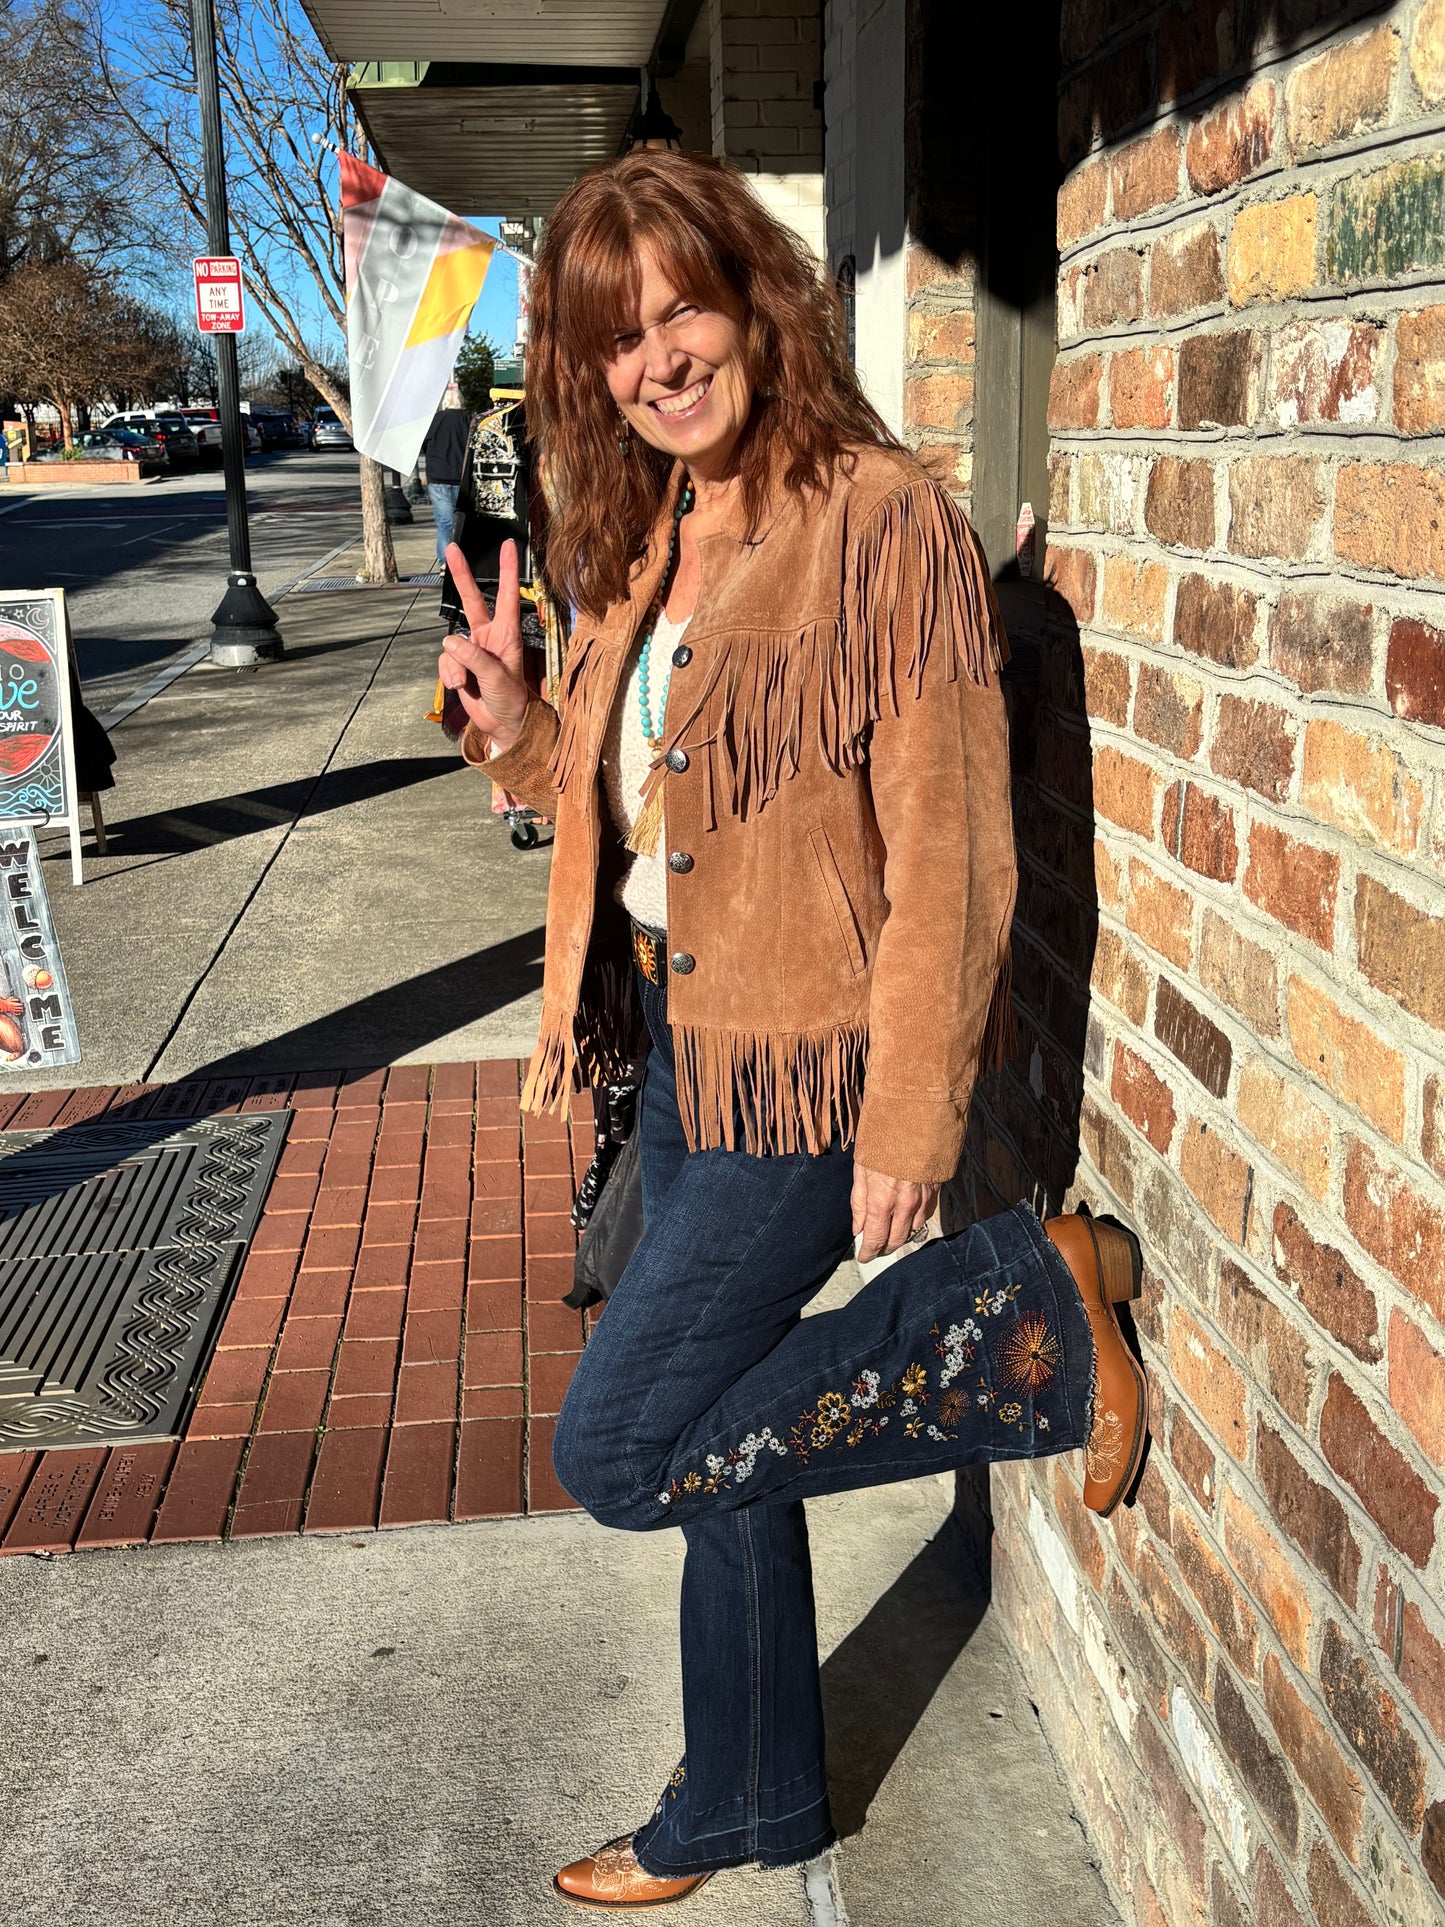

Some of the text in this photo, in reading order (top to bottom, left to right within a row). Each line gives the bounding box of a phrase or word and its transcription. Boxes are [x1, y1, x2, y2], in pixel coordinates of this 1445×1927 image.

[196, 262, 236, 277] NO PARKING
[209, 287, 227, 297] ANY
[209, 300, 229, 309] TIME
[201, 313, 241, 322] TOW-AWAY
[211, 321, 231, 330] ZONE
[0, 721, 38, 733] SPIRIT
